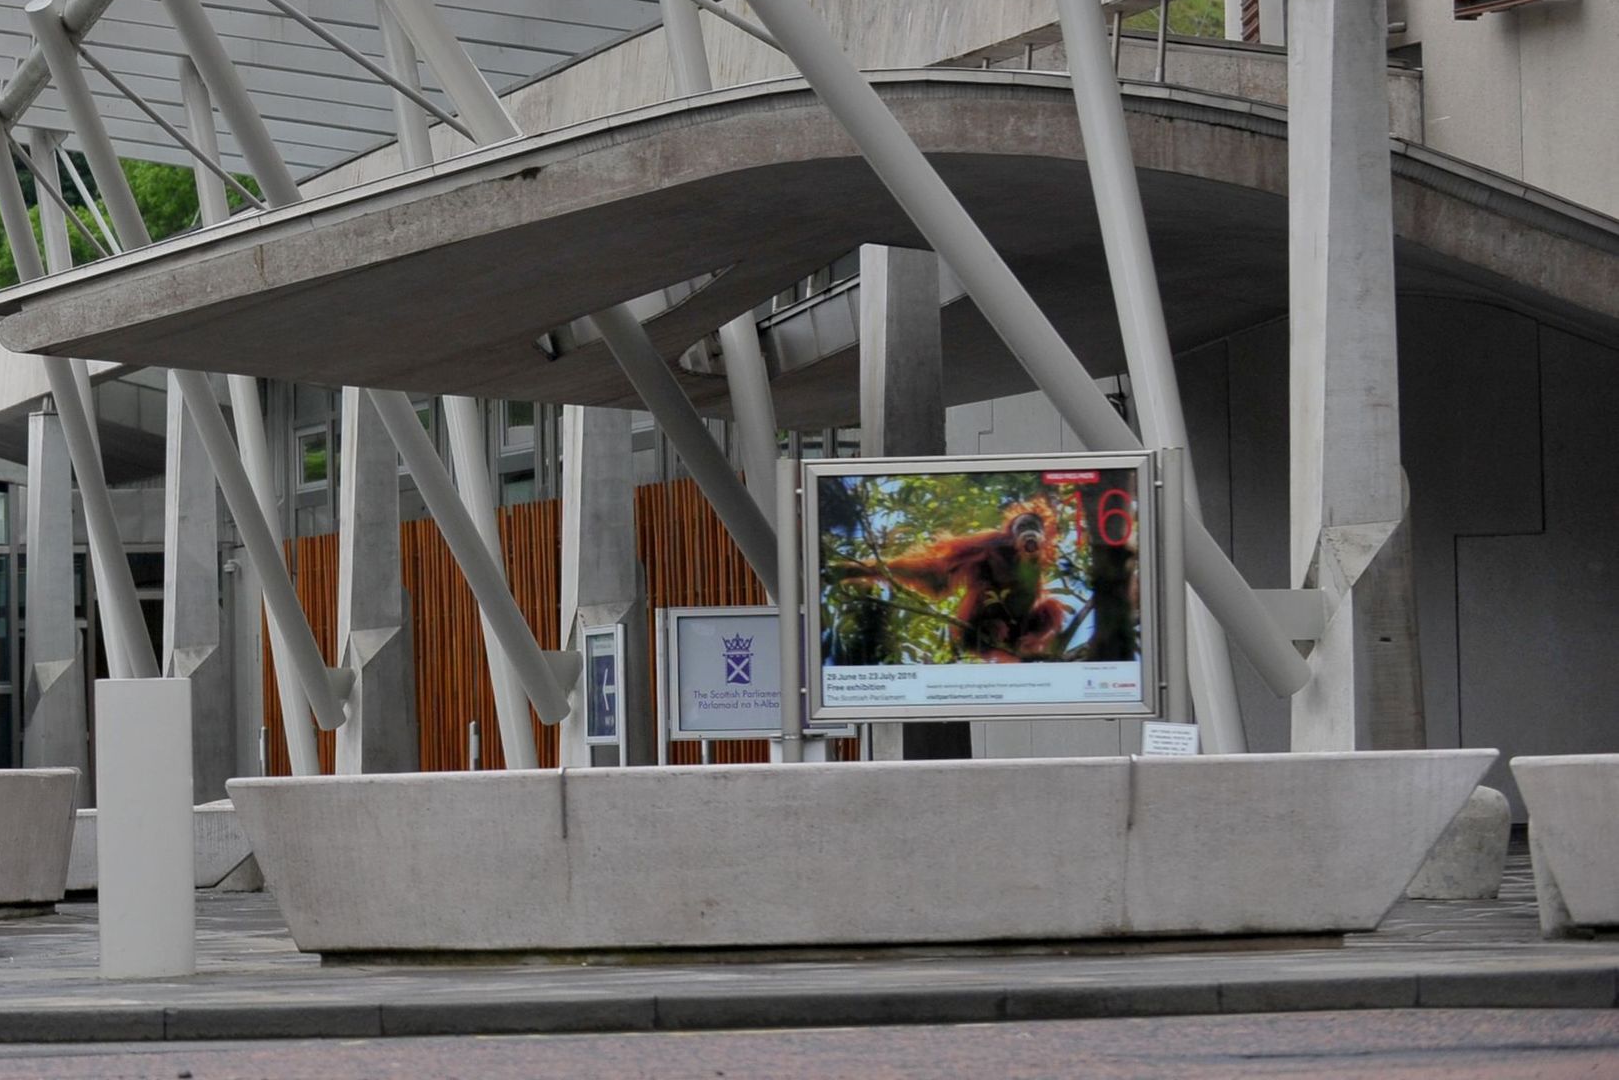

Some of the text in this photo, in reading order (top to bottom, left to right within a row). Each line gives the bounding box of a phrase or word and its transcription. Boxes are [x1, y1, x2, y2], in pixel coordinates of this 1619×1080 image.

[1062, 489, 1133, 547] 16
[838, 672, 857, 681] June
[858, 672, 867, 681] to
[868, 671, 879, 681] 23
[879, 671, 896, 682] July
[826, 683, 886, 691] Free exhibition
[694, 689, 781, 699] The Scottish Parliamen
[741, 700, 752, 709] na
[753, 699, 780, 709] h-Alba
